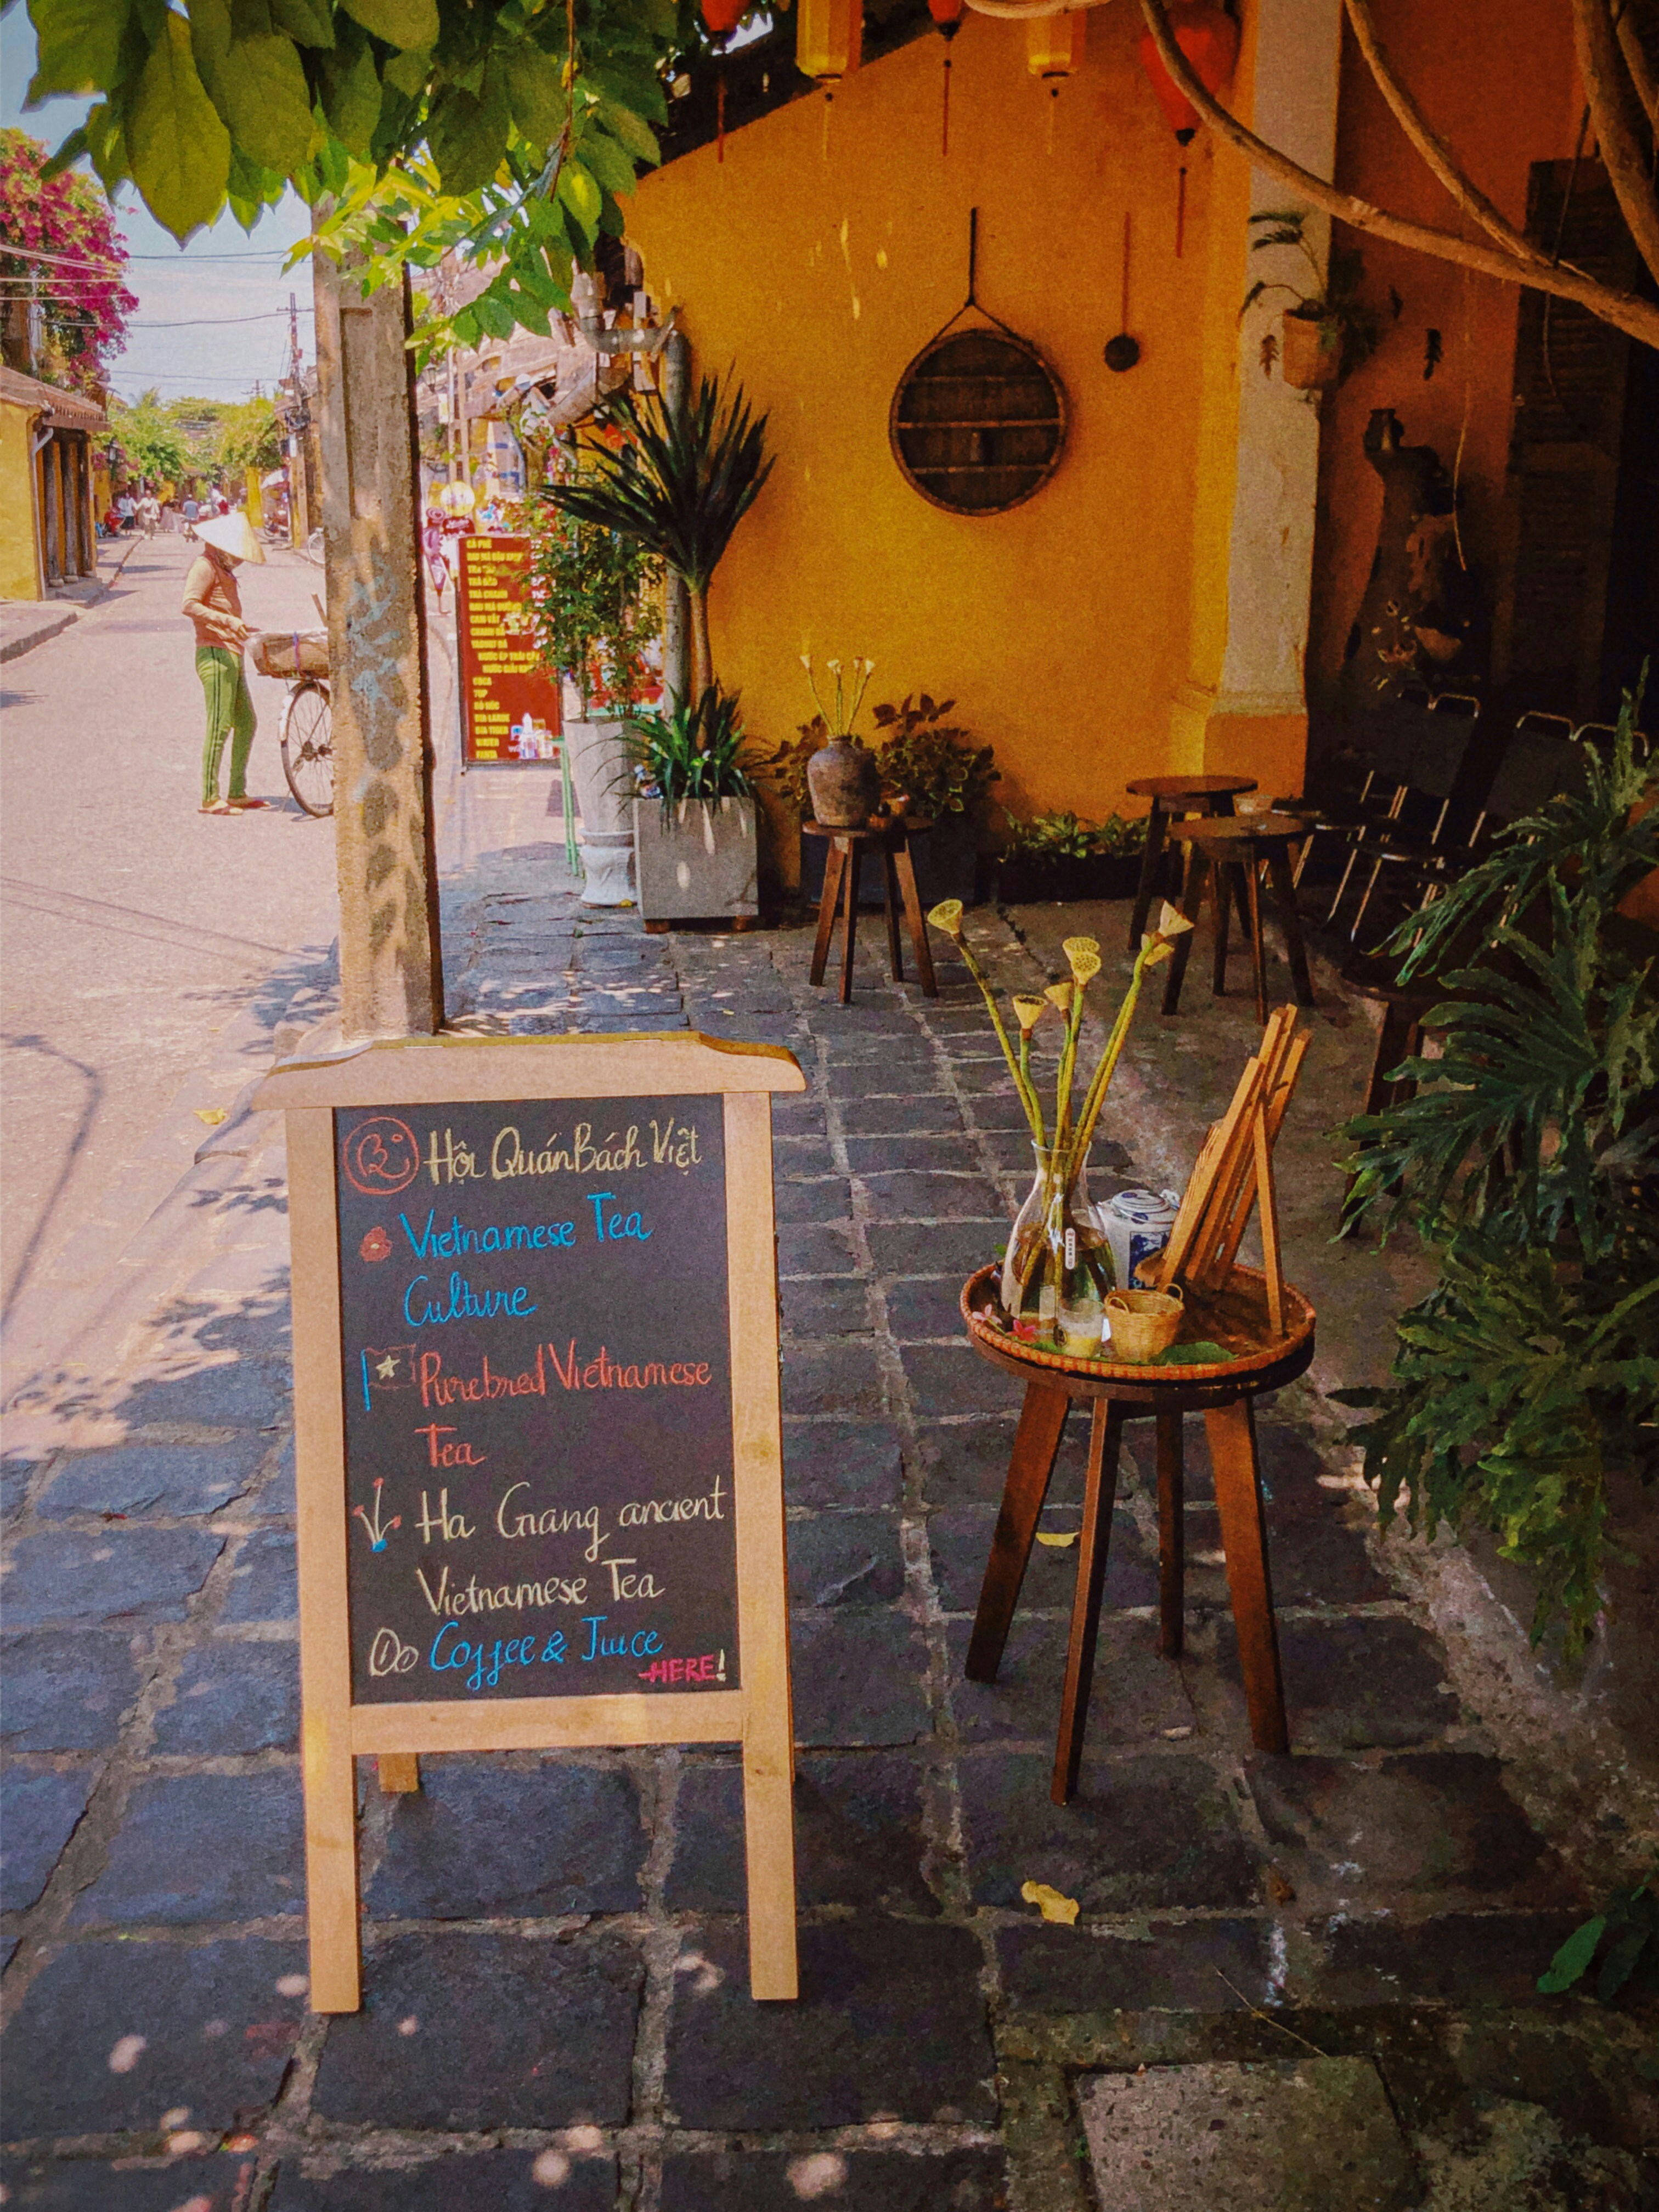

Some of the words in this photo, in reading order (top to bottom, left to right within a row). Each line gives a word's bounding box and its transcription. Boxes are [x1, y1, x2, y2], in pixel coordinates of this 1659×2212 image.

[492, 1126, 573, 1180] Quán
[573, 1122, 648, 1173] Bách
[399, 1209, 576, 1260] Vietnamese
[587, 1192, 654, 1243] Tea
[404, 1271, 539, 1327] Culture
[420, 1344, 546, 1407] Purebred
[549, 1339, 712, 1391] Vietnamese
[414, 1423, 488, 1468] Tea
[415, 1487, 476, 1544] Ha
[619, 1475, 727, 1527] ancient
[415, 1566, 588, 1616] Vietnamese
[601, 1558, 665, 1601] Tea
[428, 1620, 536, 1691] Coffee
[540, 1630, 568, 1663] &
[582, 1615, 665, 1660] Juice
